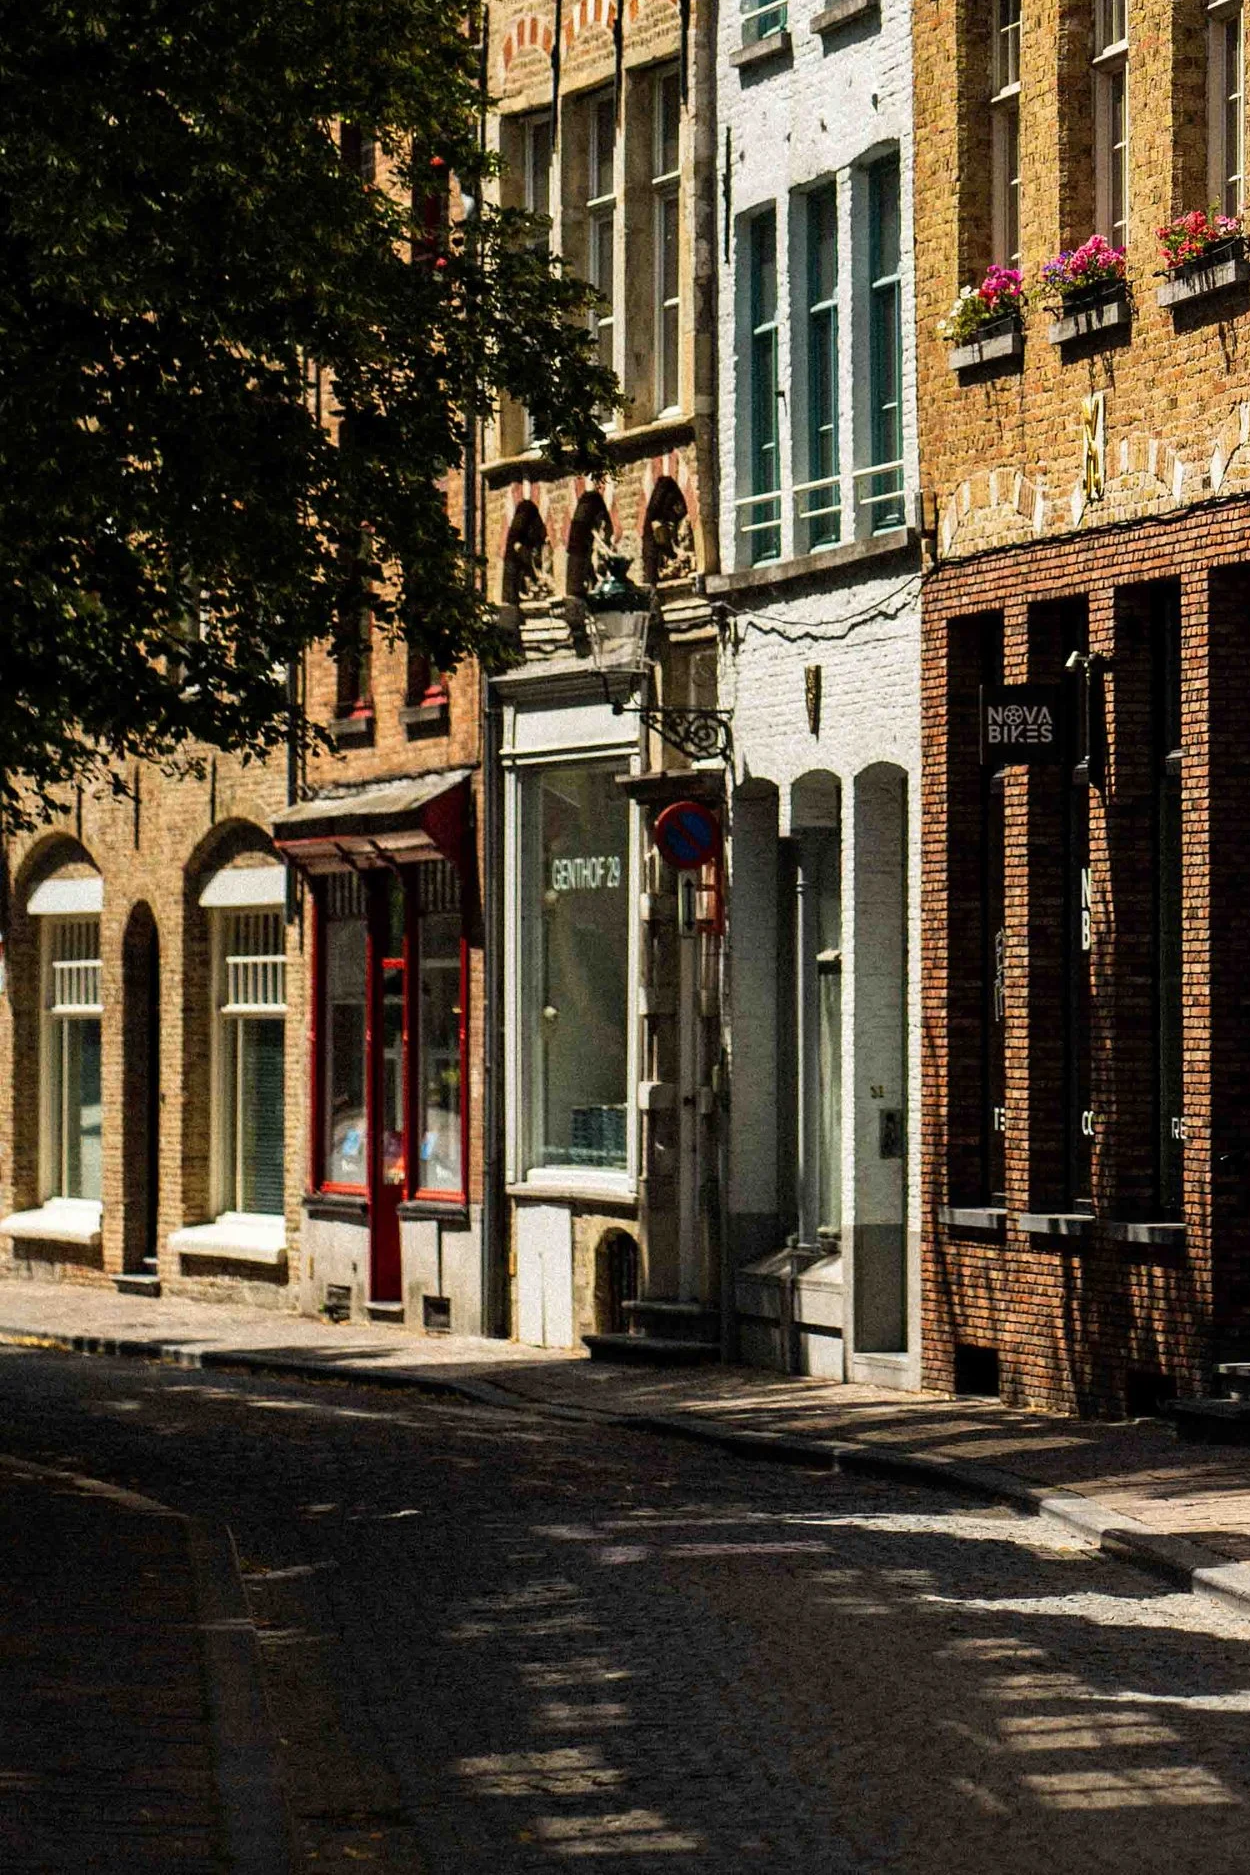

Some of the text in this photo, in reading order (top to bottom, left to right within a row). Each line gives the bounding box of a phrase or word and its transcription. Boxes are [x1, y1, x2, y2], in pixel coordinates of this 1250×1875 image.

[987, 705, 1053, 725] NOVA
[987, 725, 1053, 743] BIKES
[551, 855, 621, 891] GENTHOF 29
